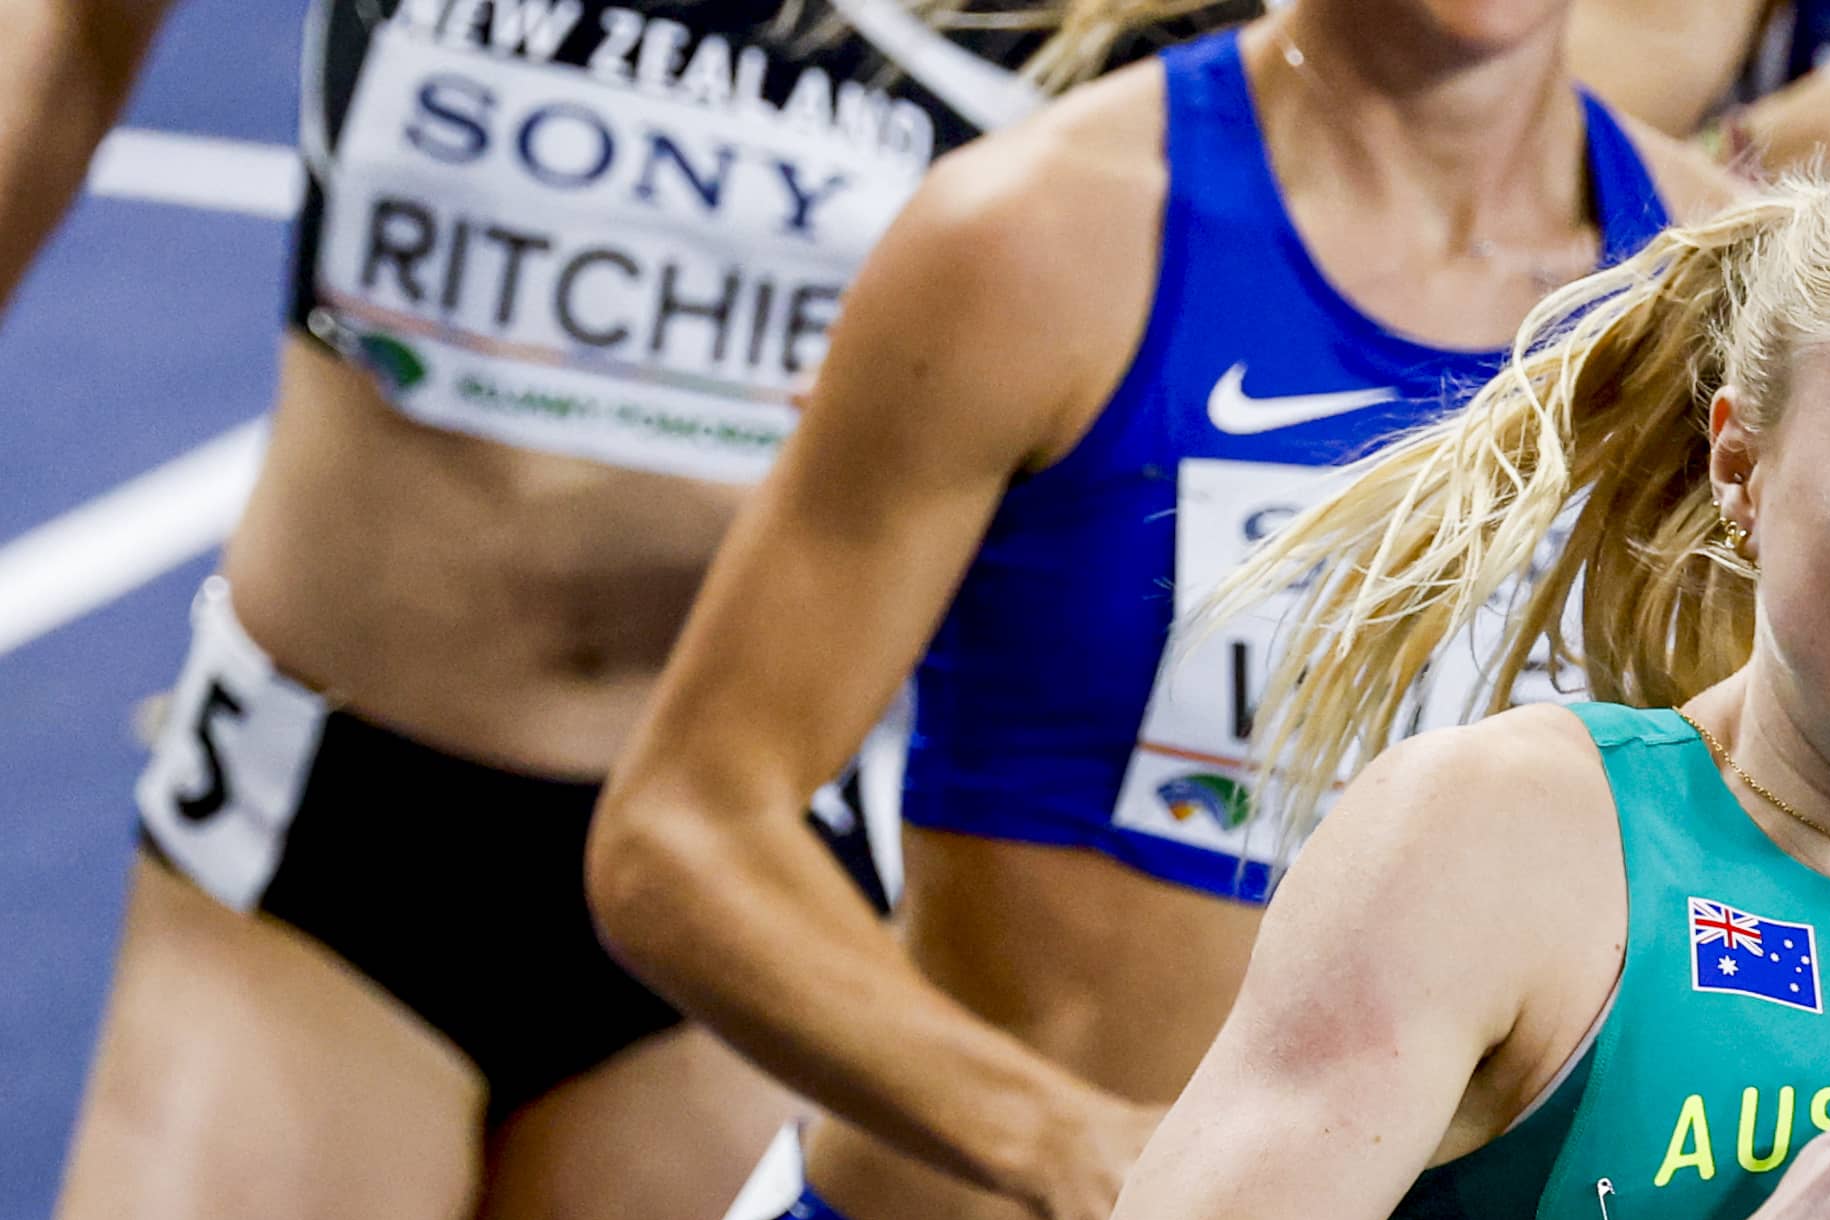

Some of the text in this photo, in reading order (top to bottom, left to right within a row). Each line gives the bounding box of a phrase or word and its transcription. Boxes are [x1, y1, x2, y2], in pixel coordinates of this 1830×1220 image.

[404, 72, 852, 240] SONY
[590, 8, 936, 165] ZEALAND
[359, 196, 844, 374] RITCHIE
[174, 678, 246, 826] 5
